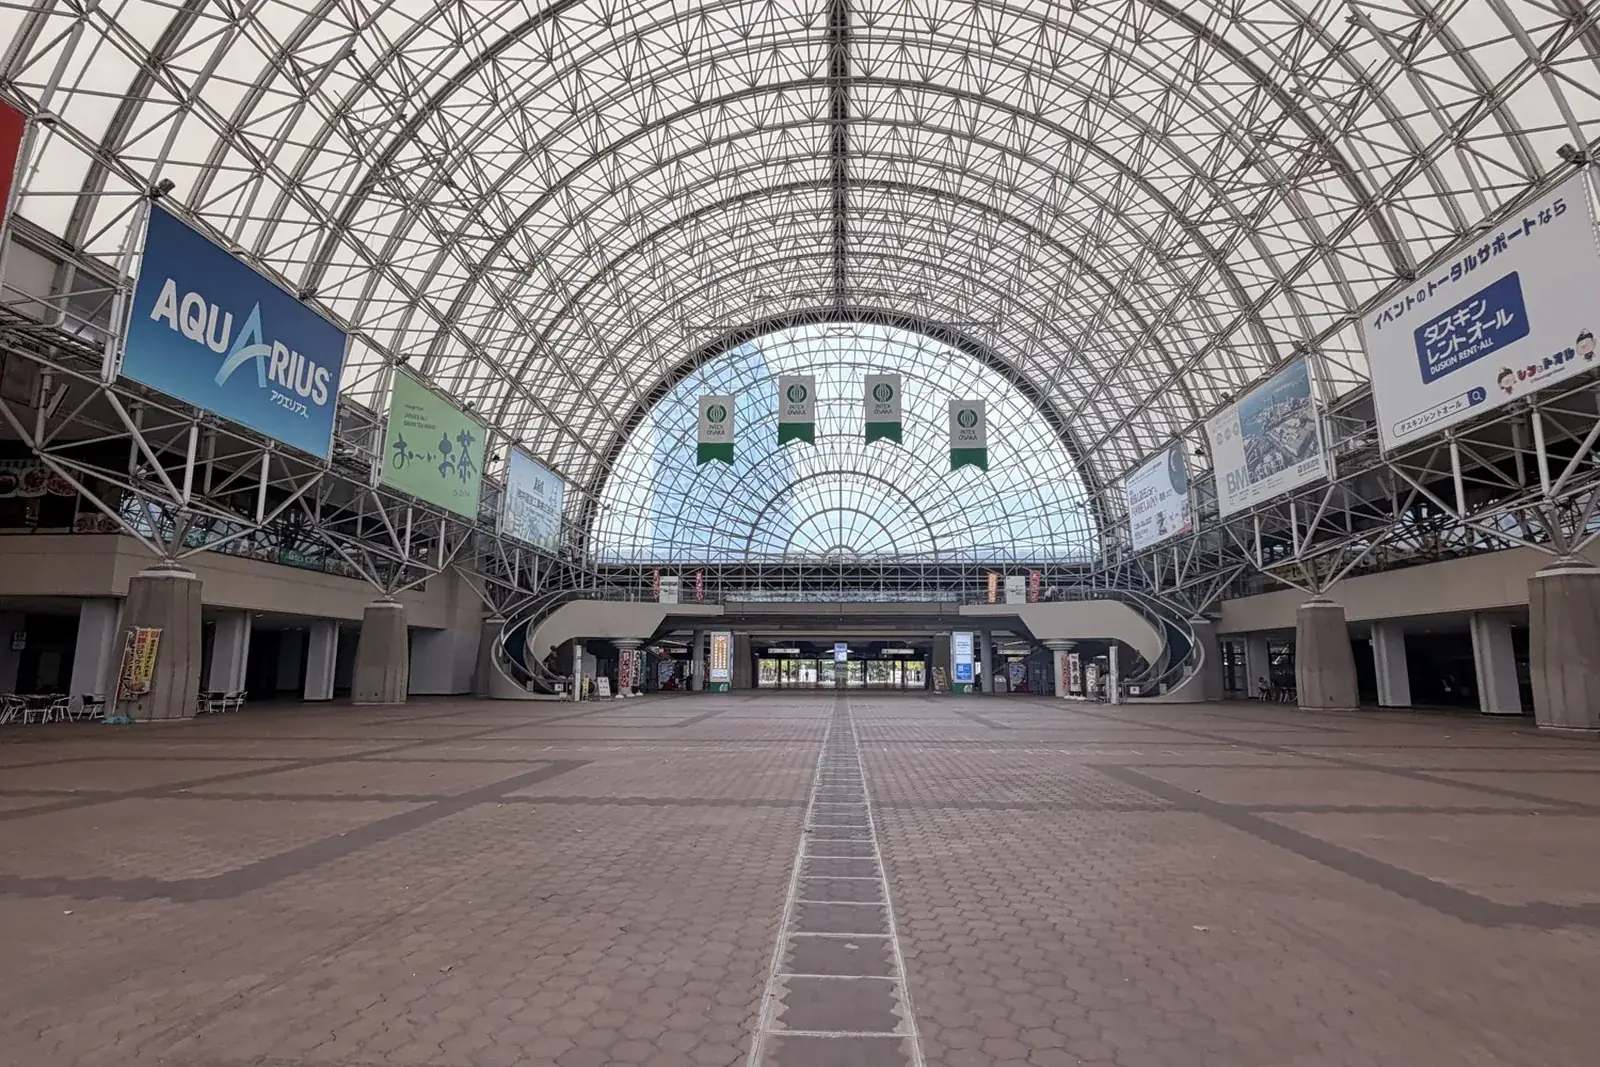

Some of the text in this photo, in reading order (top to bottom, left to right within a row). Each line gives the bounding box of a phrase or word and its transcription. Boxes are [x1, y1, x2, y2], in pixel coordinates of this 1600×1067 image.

[1374, 198, 1567, 330] イベントのトータルサポートなら
[150, 278, 331, 406] AQUARIUS
[1424, 299, 1486, 346] ダスキン
[1427, 308, 1514, 365] レントオール
[1430, 337, 1494, 375] DUSKIN RENT-ALL
[270, 390, 308, 417] アクエリアス
[1400, 401, 1462, 432] ダスキンレントオール
